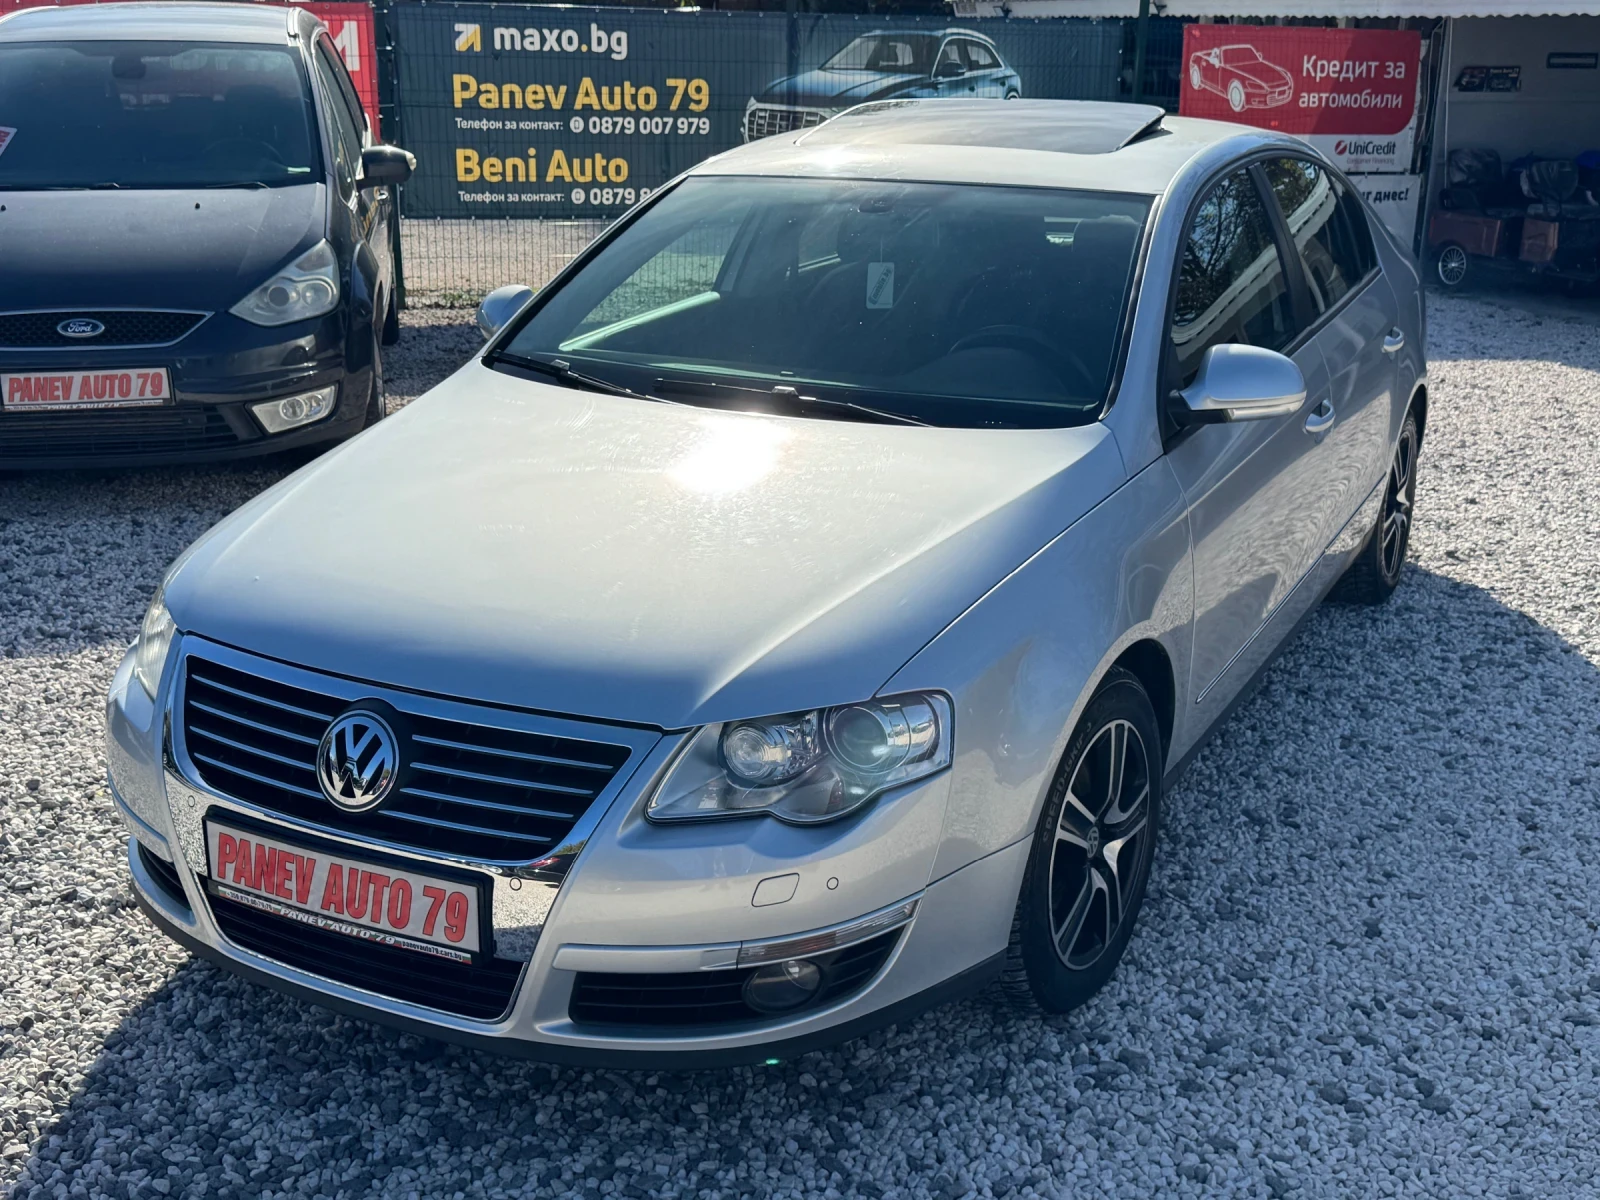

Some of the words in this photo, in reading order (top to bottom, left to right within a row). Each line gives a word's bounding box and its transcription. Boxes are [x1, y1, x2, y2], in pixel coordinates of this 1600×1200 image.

[493, 22, 628, 60] maxo.bg
[1302, 54, 1379, 82] Кредит
[1383, 61, 1406, 78] за
[452, 74, 567, 110] Panev
[574, 77, 657, 111] Auto
[666, 78, 710, 112] 79
[1299, 88, 1402, 108] автомобили
[455, 117, 502, 131] Телефон
[504, 120, 517, 130] за
[519, 119, 564, 130] контакт:
[588, 116, 635, 134] 0879
[639, 116, 674, 134] 007
[676, 117, 710, 135] 979
[1348, 140, 1396, 156] UniCredit
[456, 148, 538, 182] Beni
[545, 149, 629, 182] Auto
[458, 190, 505, 204] Телефон
[506, 193, 519, 203] за
[521, 192, 565, 203] контакт:
[589, 188, 636, 205] 0879
[1373, 187, 1409, 204] днес!
[68, 321, 92, 332] Ford
[9, 377, 73, 402] PANEV
[79, 374, 131, 399] AUTO
[137, 372, 163, 397] 79
[218, 832, 315, 904] PANEV
[320, 863, 412, 930] AUTO
[422, 885, 469, 943] 79
[280, 908, 327, 927] PANEV
[330, 922, 371, 939] AUTO
[375, 933, 396, 945] 79
